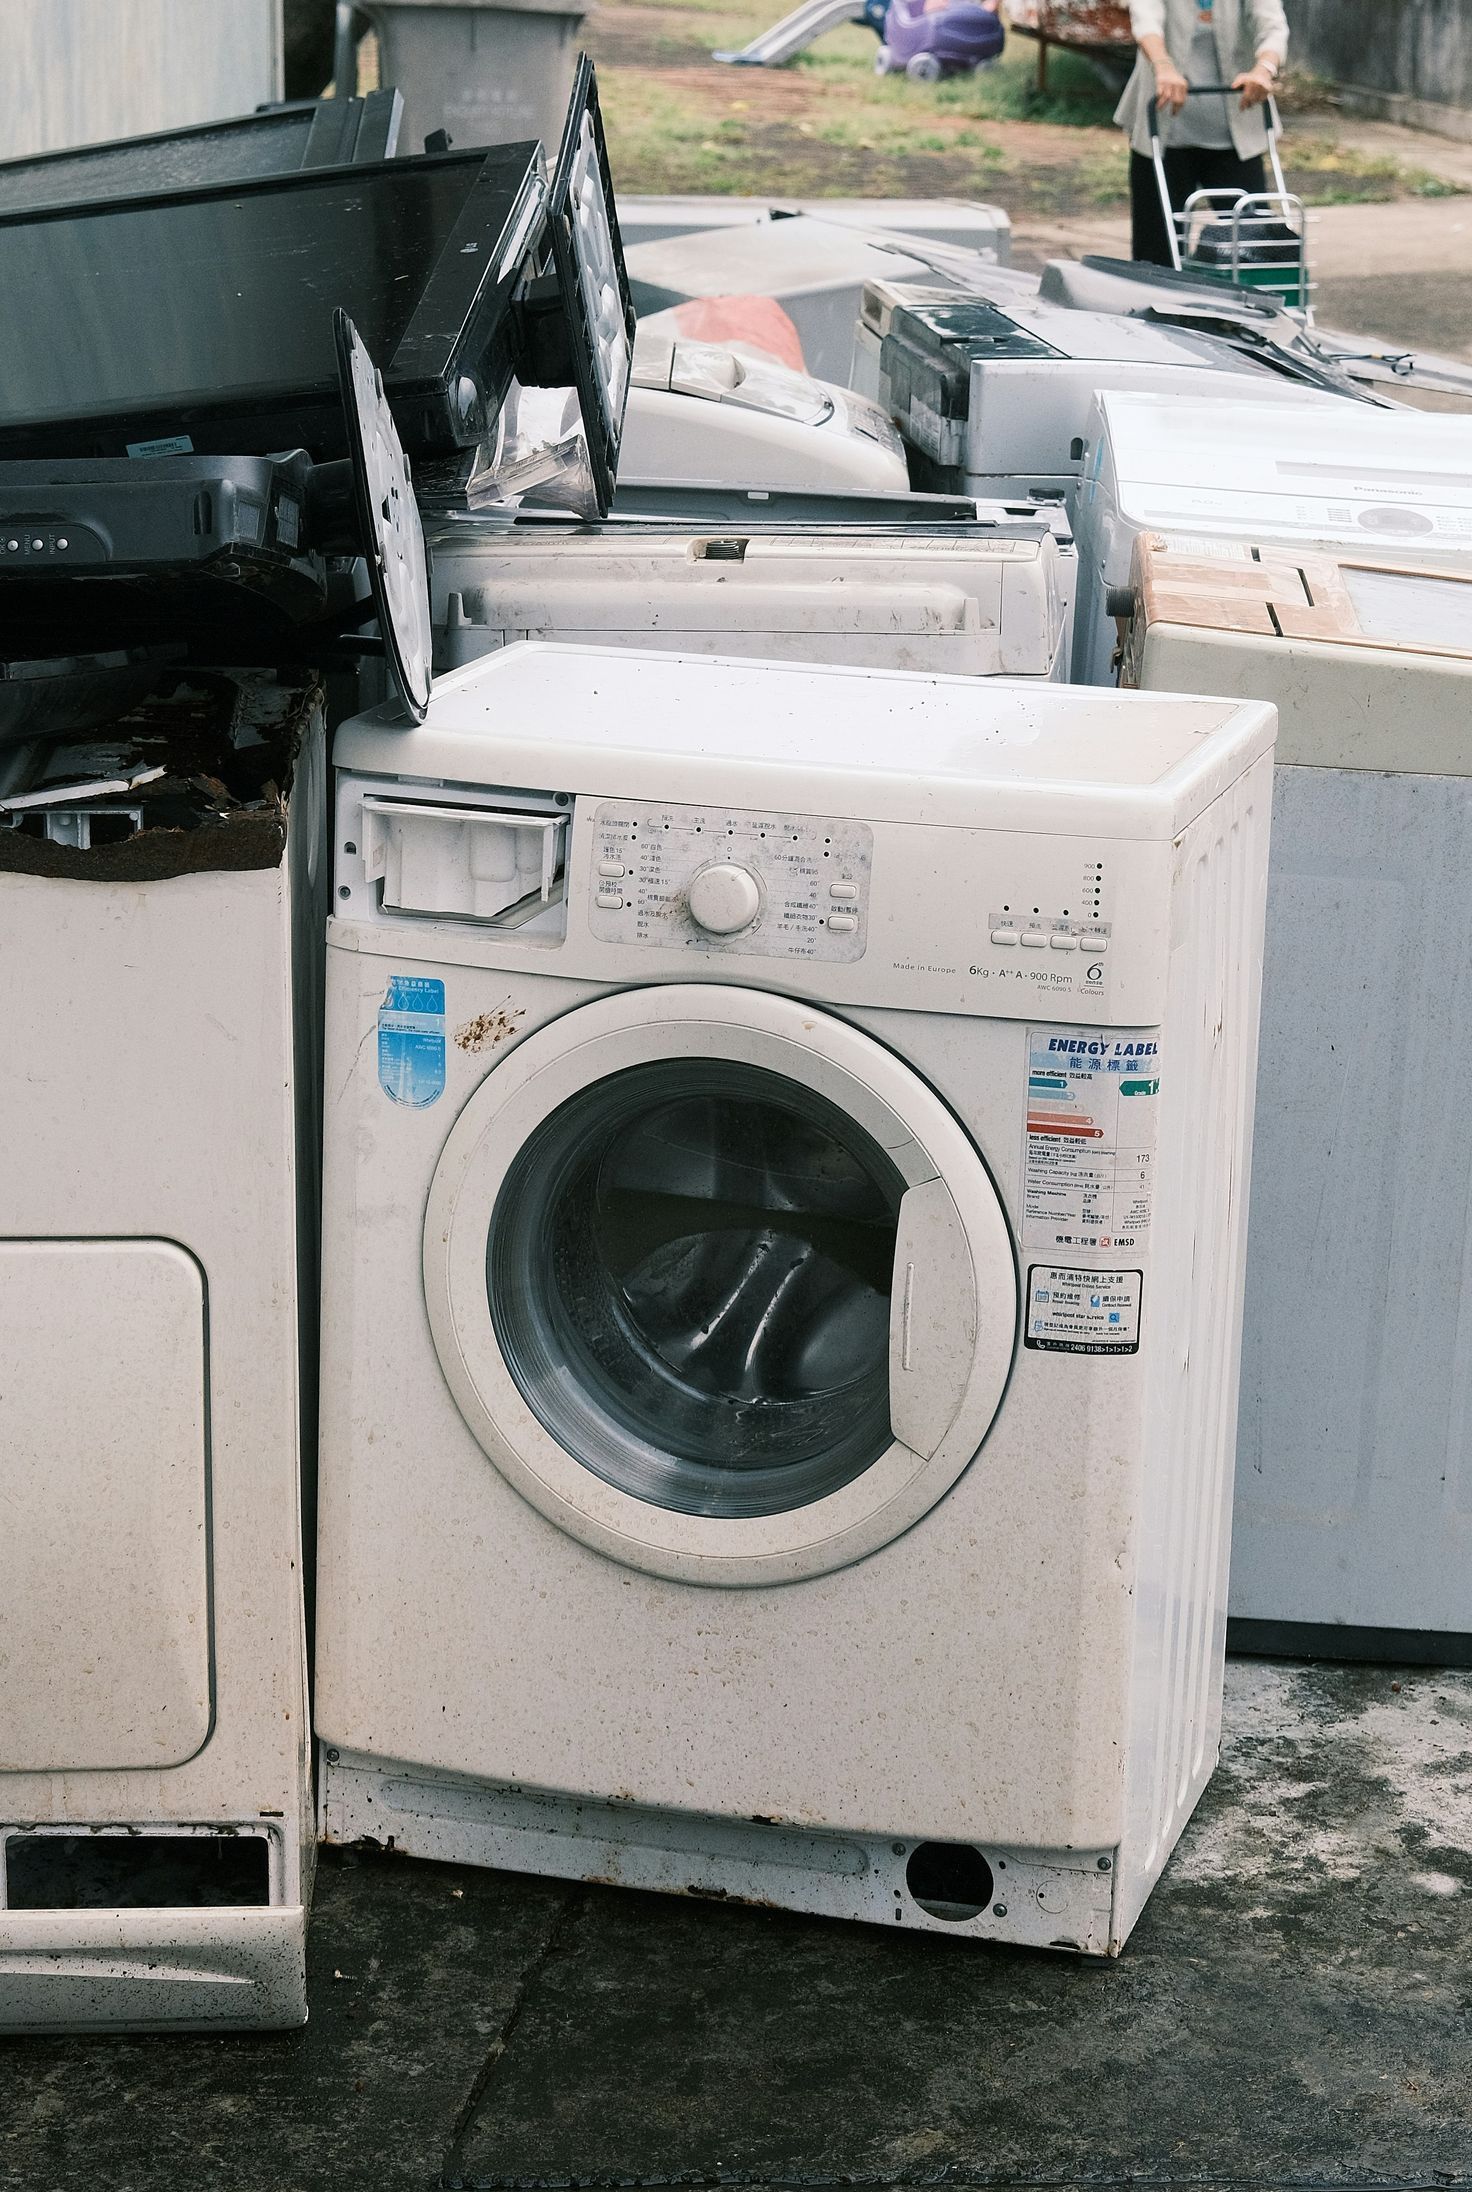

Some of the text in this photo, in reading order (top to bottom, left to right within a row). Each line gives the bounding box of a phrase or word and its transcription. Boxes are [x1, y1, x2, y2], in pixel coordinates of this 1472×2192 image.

[893, 962, 915, 971] Made
[928, 965, 957, 975] Europe
[969, 965, 989, 979] 6Kg
[1015, 970, 1023, 979] A
[1030, 971, 1048, 982] 900
[1050, 973, 1073, 985] Rpm
[1080, 987, 1105, 997] Colours
[1048, 1038, 1158, 1056] ENERGY LABEL
[1068, 1056, 1139, 1072] 能源標籤
[1031, 1069, 1046, 1077] more
[1046, 1070, 1067, 1078] efficient
[1040, 1135, 1061, 1143] efficient
[1029, 1143, 1045, 1151] Annual
[1045, 1144, 1061, 1152] Energy
[1061, 1146, 1092, 1155] Consumption
[1136, 1153, 1150, 1163] 173
[1028, 1167, 1048, 1175] Washing
[1048, 1168, 1069, 1177] Capacity
[1140, 1170, 1146, 1180] 6
[1042, 1179, 1074, 1188] Consumption
[1114, 1238, 1135, 1247] EMSD
[1049, 1271, 1124, 1284] 惠而浦特快網上支援
[1052, 1311, 1075, 1319] whirlpool
[1070, 1343, 1086, 1352] 2406
